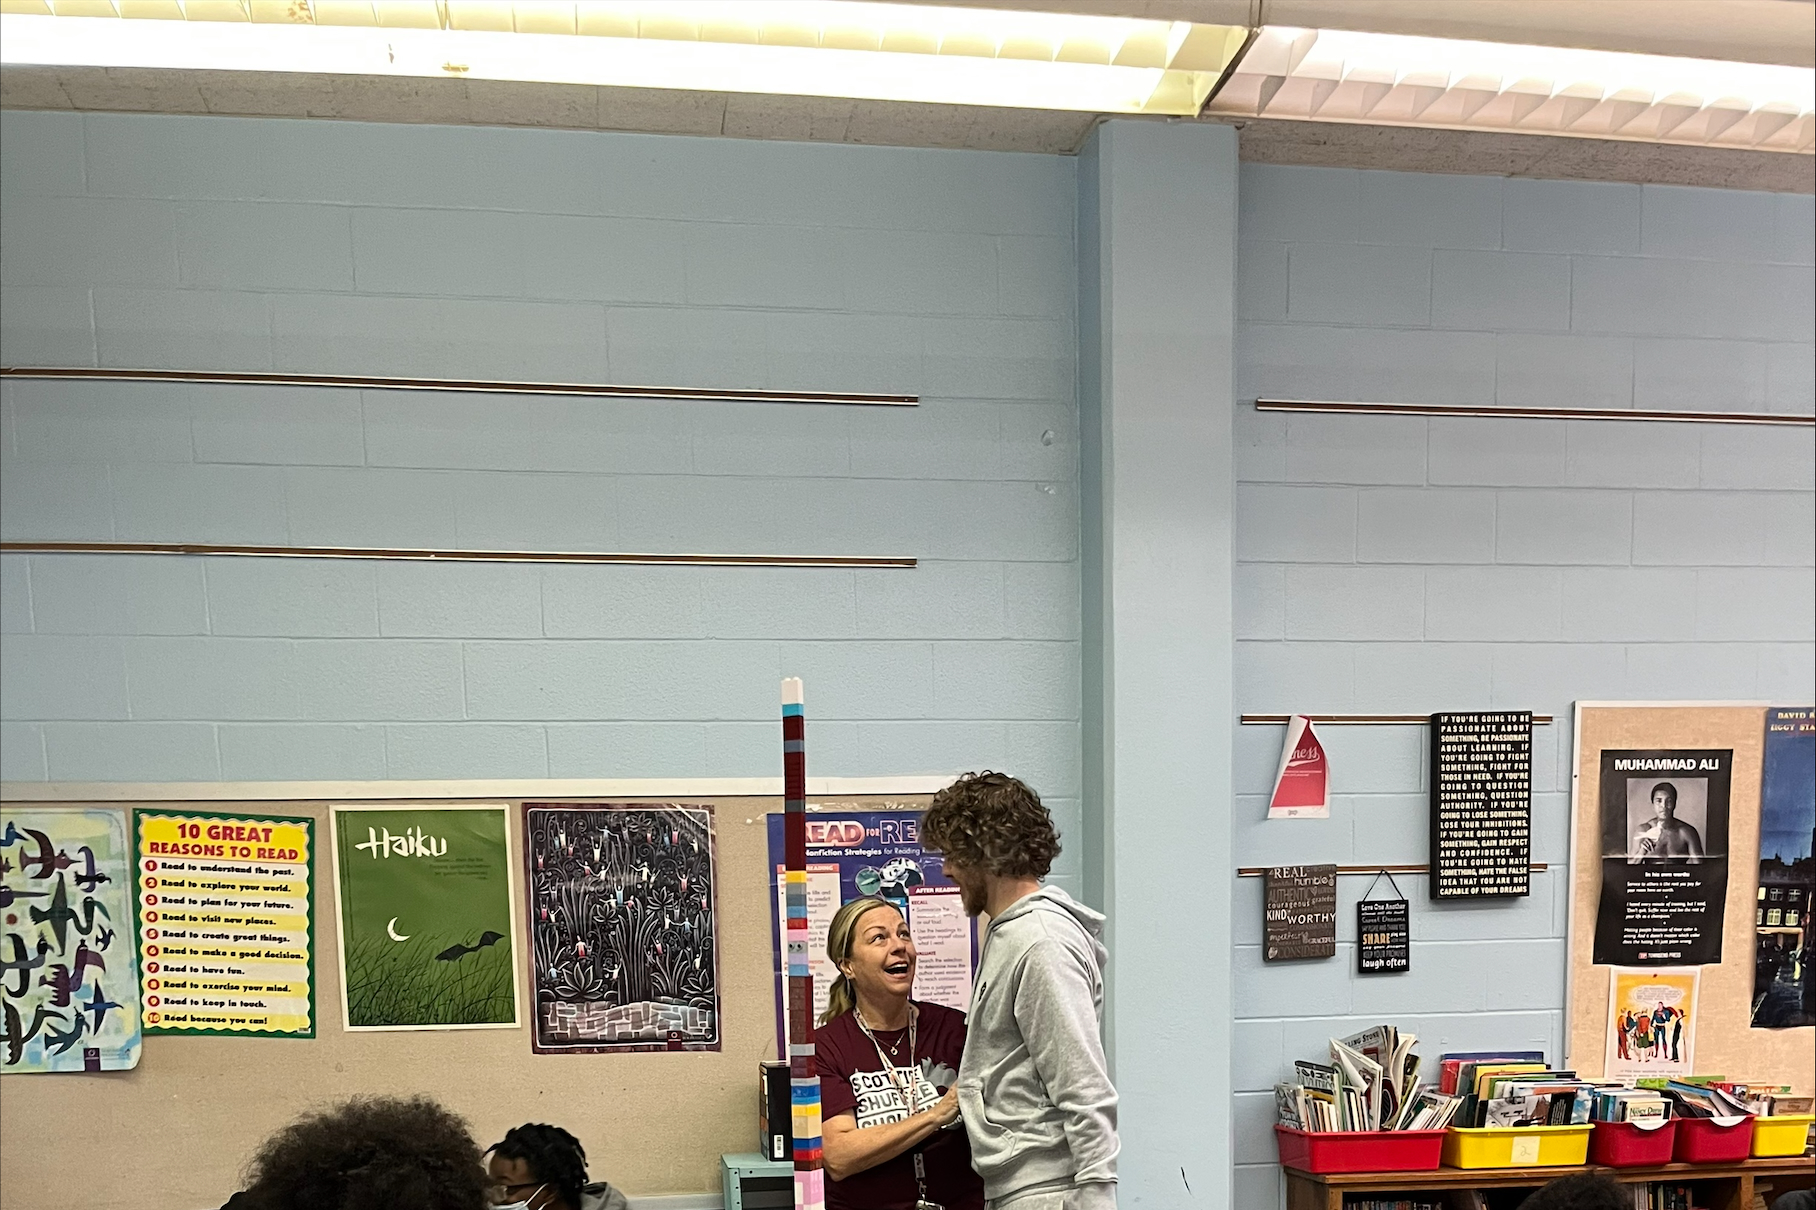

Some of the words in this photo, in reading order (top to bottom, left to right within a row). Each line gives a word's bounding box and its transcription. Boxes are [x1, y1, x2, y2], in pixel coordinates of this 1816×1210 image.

[1441, 715, 1448, 723] IF
[1451, 715, 1478, 723] YOU'RE
[1520, 714, 1529, 722] BE
[1441, 724, 1496, 732] PASSIONATE
[1500, 724, 1529, 732] ABOUT
[1440, 734, 1479, 743] SOMETHING,
[1480, 734, 1489, 742] BE
[1440, 744, 1467, 752] ABOUT
[1470, 743, 1514, 752] LEARNING.
[1470, 753, 1493, 761] GOING
[1496, 753, 1505, 761] TO
[1440, 763, 1487, 771] SOMETHING,
[1514, 762, 1528, 770] FOR
[1614, 758, 1696, 771] MUHAMMAD
[1698, 758, 1720, 770] ALI
[1440, 773, 1462, 781] THOSE
[1496, 772, 1503, 780] IF
[1471, 782, 1481, 790] TO
[1486, 781, 1528, 790] QUESTION
[1440, 792, 1487, 800] SOMETHING,
[1490, 791, 1528, 799] QUESTION
[1440, 801, 1484, 809] AUTHORITY.
[1500, 800, 1528, 808] YOU'RE
[1440, 811, 1460, 819] GOING
[1461, 811, 1470, 819] TO
[1471, 811, 1488, 819] LOSE
[1489, 810, 1528, 818] SOMETHING,
[1440, 821, 1458, 829] LOSE
[1460, 820, 1479, 828] YOUR
[1482, 819, 1528, 828] INHIBITIONS.
[177, 822, 200, 838] 10
[207, 825, 272, 842] GREAT
[866, 828, 880, 837] FOR
[1448, 830, 1474, 838] YOU'RE
[1476, 829, 1498, 837] GOING
[355, 826, 448, 860] Haiku
[1440, 840, 1480, 848] SOMETHING,
[1481, 839, 1497, 847] GAIN
[1498, 838, 1528, 846] RESPECT
[150, 842, 224, 857] REASONS
[230, 846, 252, 858] TO
[257, 848, 298, 860] READ
[844, 848, 882, 858] Strategies
[894, 848, 920, 856] Reading
[1460, 848, 1513, 857] CONFIDENCE.
[1520, 847, 1527, 855] IF
[1440, 859, 1467, 867] YOU'RE
[1470, 858, 1494, 866] GOING
[161, 862, 184, 870] Read
[187, 863, 197, 871] to
[200, 864, 252, 873] understand
[255, 866, 269, 874] the
[1274, 867, 1308, 879] REAL
[1440, 868, 1477, 876] SOMETHING,
[1508, 866, 1527, 874] FALSE
[161, 879, 185, 887] Read
[200, 881, 236, 890] explore
[262, 884, 291, 892] world.
[1440, 878, 1457, 886] IDEA
[1459, 877, 1477, 885] THAT
[1496, 876, 1510, 884] ARE
[1440, 887, 1469, 895] CAPABLE
[1480, 886, 1498, 894] YOUR
[1499, 885, 1527, 893] DREAMS
[161, 896, 185, 904] Read
[201, 898, 221, 907] plan
[224, 898, 238, 906] for
[263, 900, 293, 909] future.
[1268, 901, 1310, 909] courageous
[162, 913, 185, 921] Read
[188, 914, 198, 922] to
[201, 914, 221, 922] visit
[245, 916, 276, 926] places.
[1266, 909, 1287, 921] KIND
[1286, 912, 1336, 924] WORTHY
[162, 930, 186, 938] Read
[233, 934, 257, 942] great
[260, 934, 290, 944] things.
[1362, 933, 1390, 945] SHARE
[163, 946, 186, 954] Read
[202, 948, 227, 956] make
[239, 950, 261, 959] good
[264, 950, 304, 959] decision.
[163, 964, 186, 972] Read
[202, 965, 224, 974] have
[227, 966, 245, 974] fun.
[1362, 959, 1384, 970] laugh
[1386, 958, 1406, 968] often
[163, 980, 186, 988] Read
[202, 982, 240, 990] exercise
[266, 984, 291, 992] mind.
[164, 997, 187, 1005] Read
[202, 998, 225, 1008] keep
[240, 1000, 267, 1008] touch.
[164, 1014, 187, 1022] Read
[190, 1014, 226, 1023] because
[1519, 1146, 1531, 1156] 2
